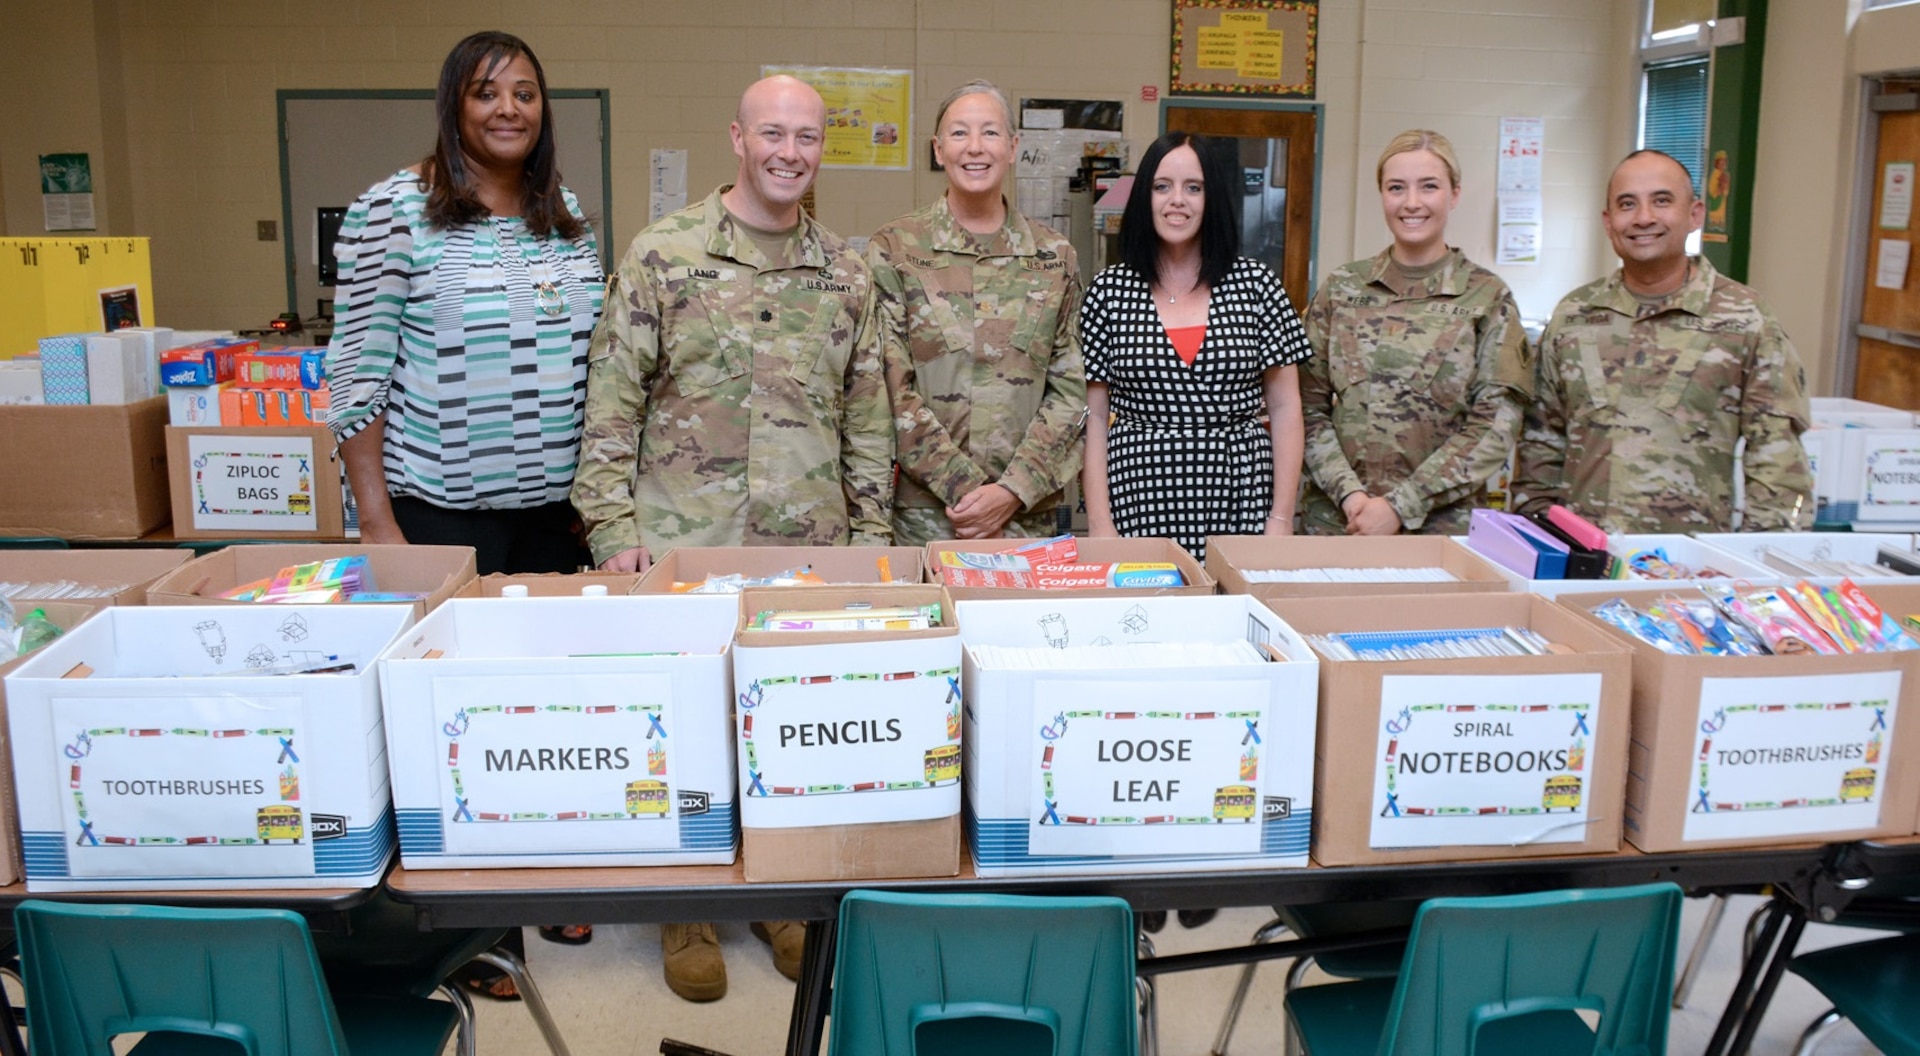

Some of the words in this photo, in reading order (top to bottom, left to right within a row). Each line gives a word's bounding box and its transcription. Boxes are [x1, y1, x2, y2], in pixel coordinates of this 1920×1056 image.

[687, 268, 720, 279] LANG
[169, 370, 197, 384] Ziploc
[306, 361, 318, 385] Ziploc
[226, 465, 280, 479] ZIPLOC
[238, 487, 279, 501] BAGS
[1036, 563, 1102, 573] Colgate
[1038, 577, 1105, 587] Colgate
[780, 718, 902, 748] PENCILS
[1453, 722, 1514, 738] SPIRAL
[485, 746, 630, 772] MARKERS
[1098, 739, 1192, 763] LOOSE
[1717, 743, 1863, 766] TOOTHBRUSHES
[1399, 750, 1567, 774] NOTEBOOKS
[103, 779, 264, 796] TOOTHBRUSHES
[1113, 779, 1180, 803] LEAF
